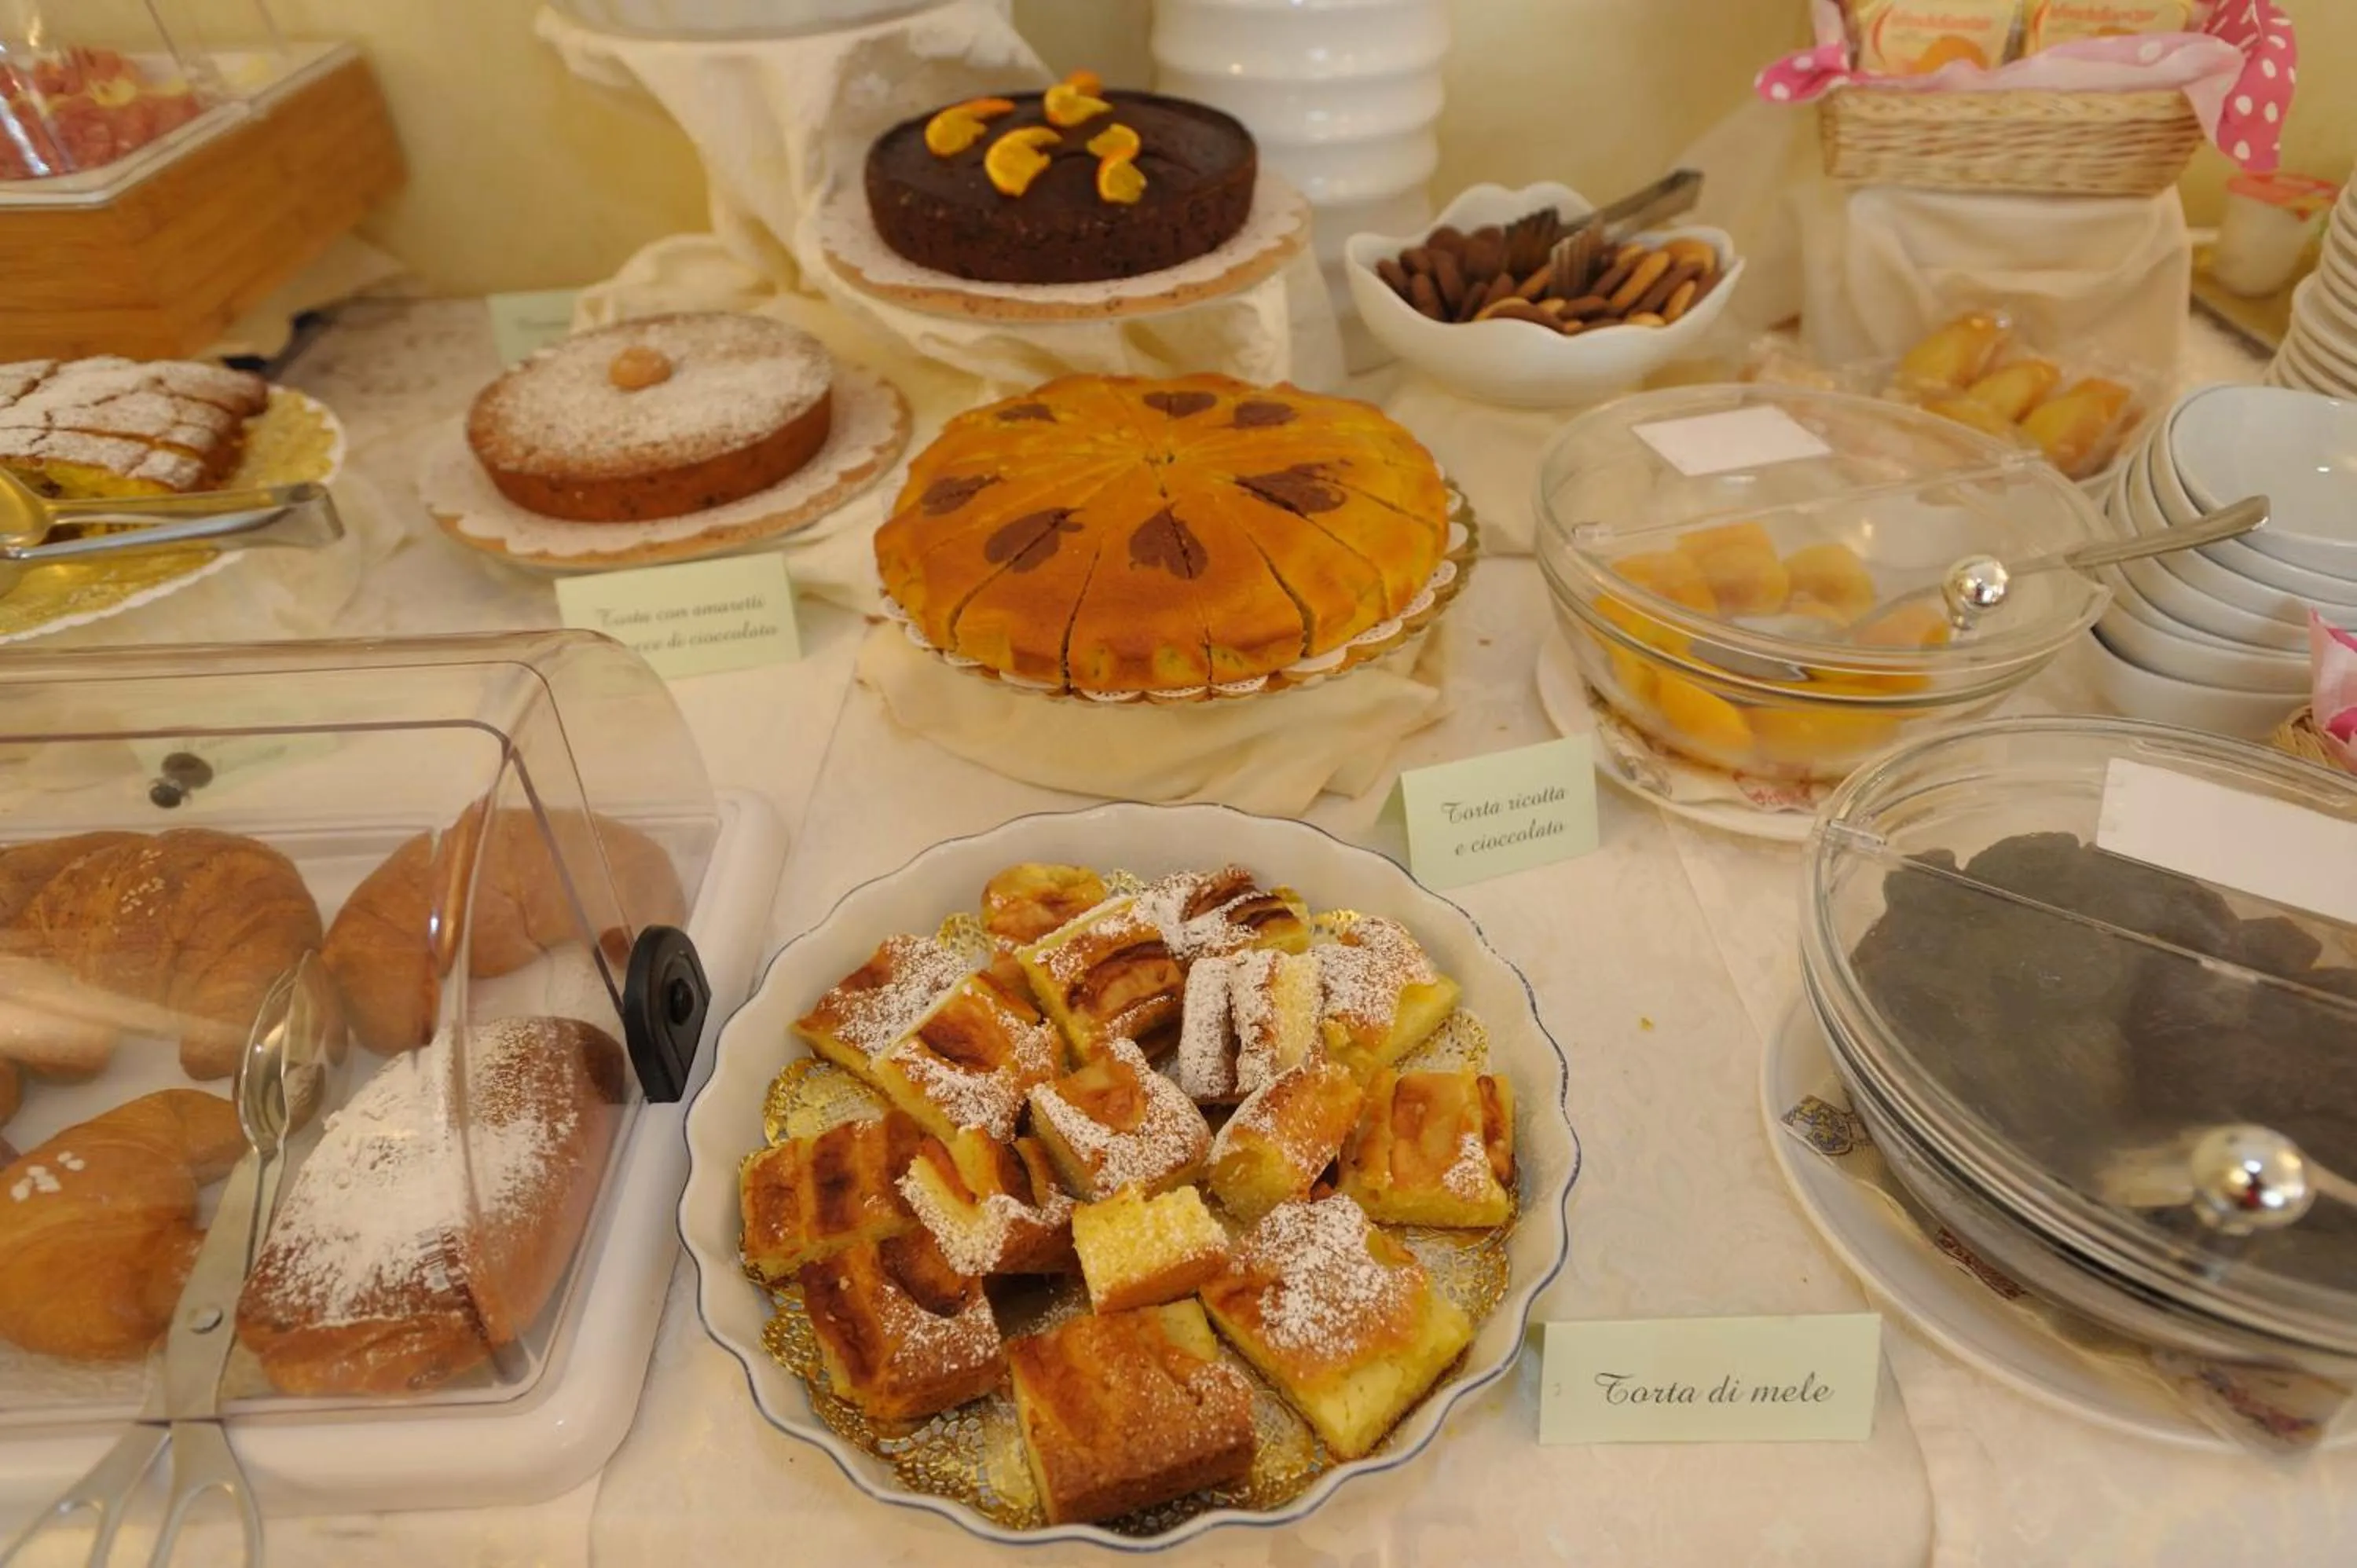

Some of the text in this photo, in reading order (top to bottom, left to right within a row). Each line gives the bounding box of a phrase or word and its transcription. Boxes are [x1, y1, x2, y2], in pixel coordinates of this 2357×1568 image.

[655, 607, 690, 622] con
[667, 630, 684, 650] di
[688, 619, 779, 648] cioccolato
[1440, 786, 1567, 825] Torta ricotta
[1454, 818, 1565, 856] e cioccolato
[1594, 1371, 1835, 1405] Torta di mele
